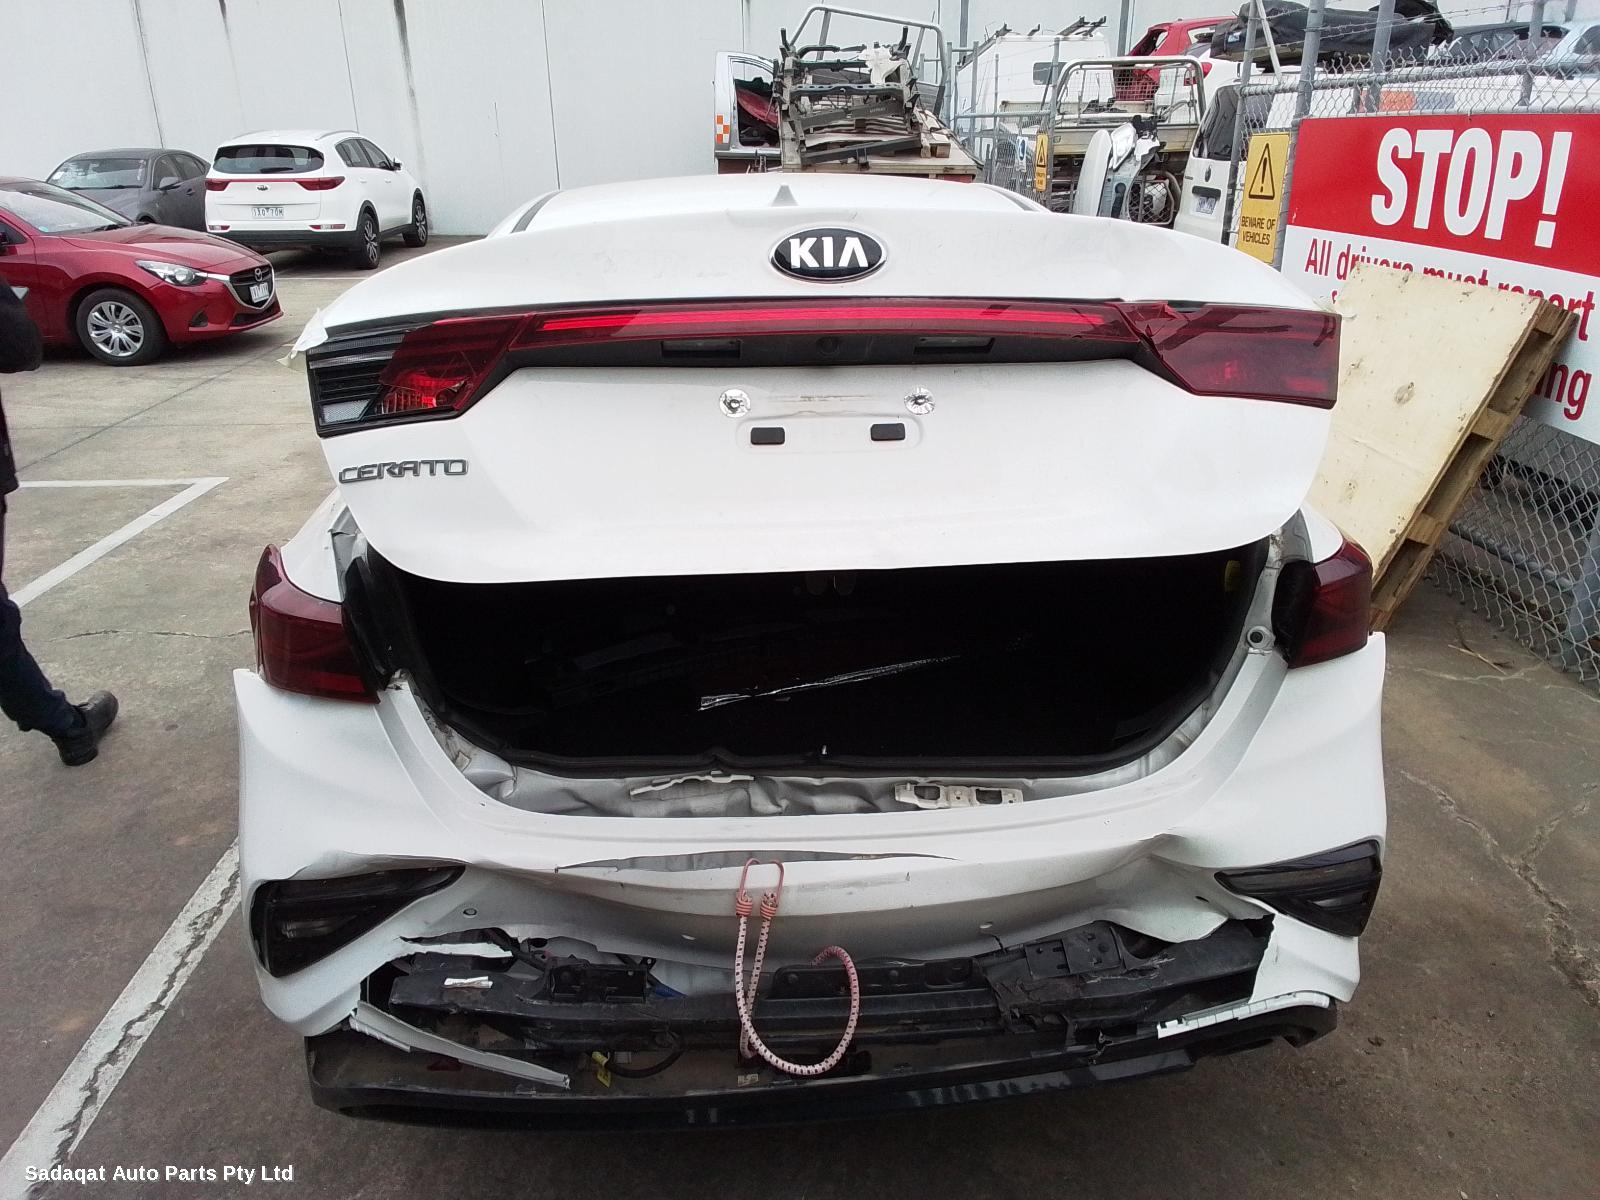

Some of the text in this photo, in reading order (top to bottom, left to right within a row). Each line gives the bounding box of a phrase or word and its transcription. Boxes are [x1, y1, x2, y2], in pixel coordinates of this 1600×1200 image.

[1371, 127, 1573, 249] STOP!
[1241, 215, 1276, 231] BEWARE OF
[788, 236, 869, 269] KIA
[1242, 230, 1271, 246] VEHICLES
[1304, 238, 1333, 277] All
[338, 458, 468, 484] CERATO
